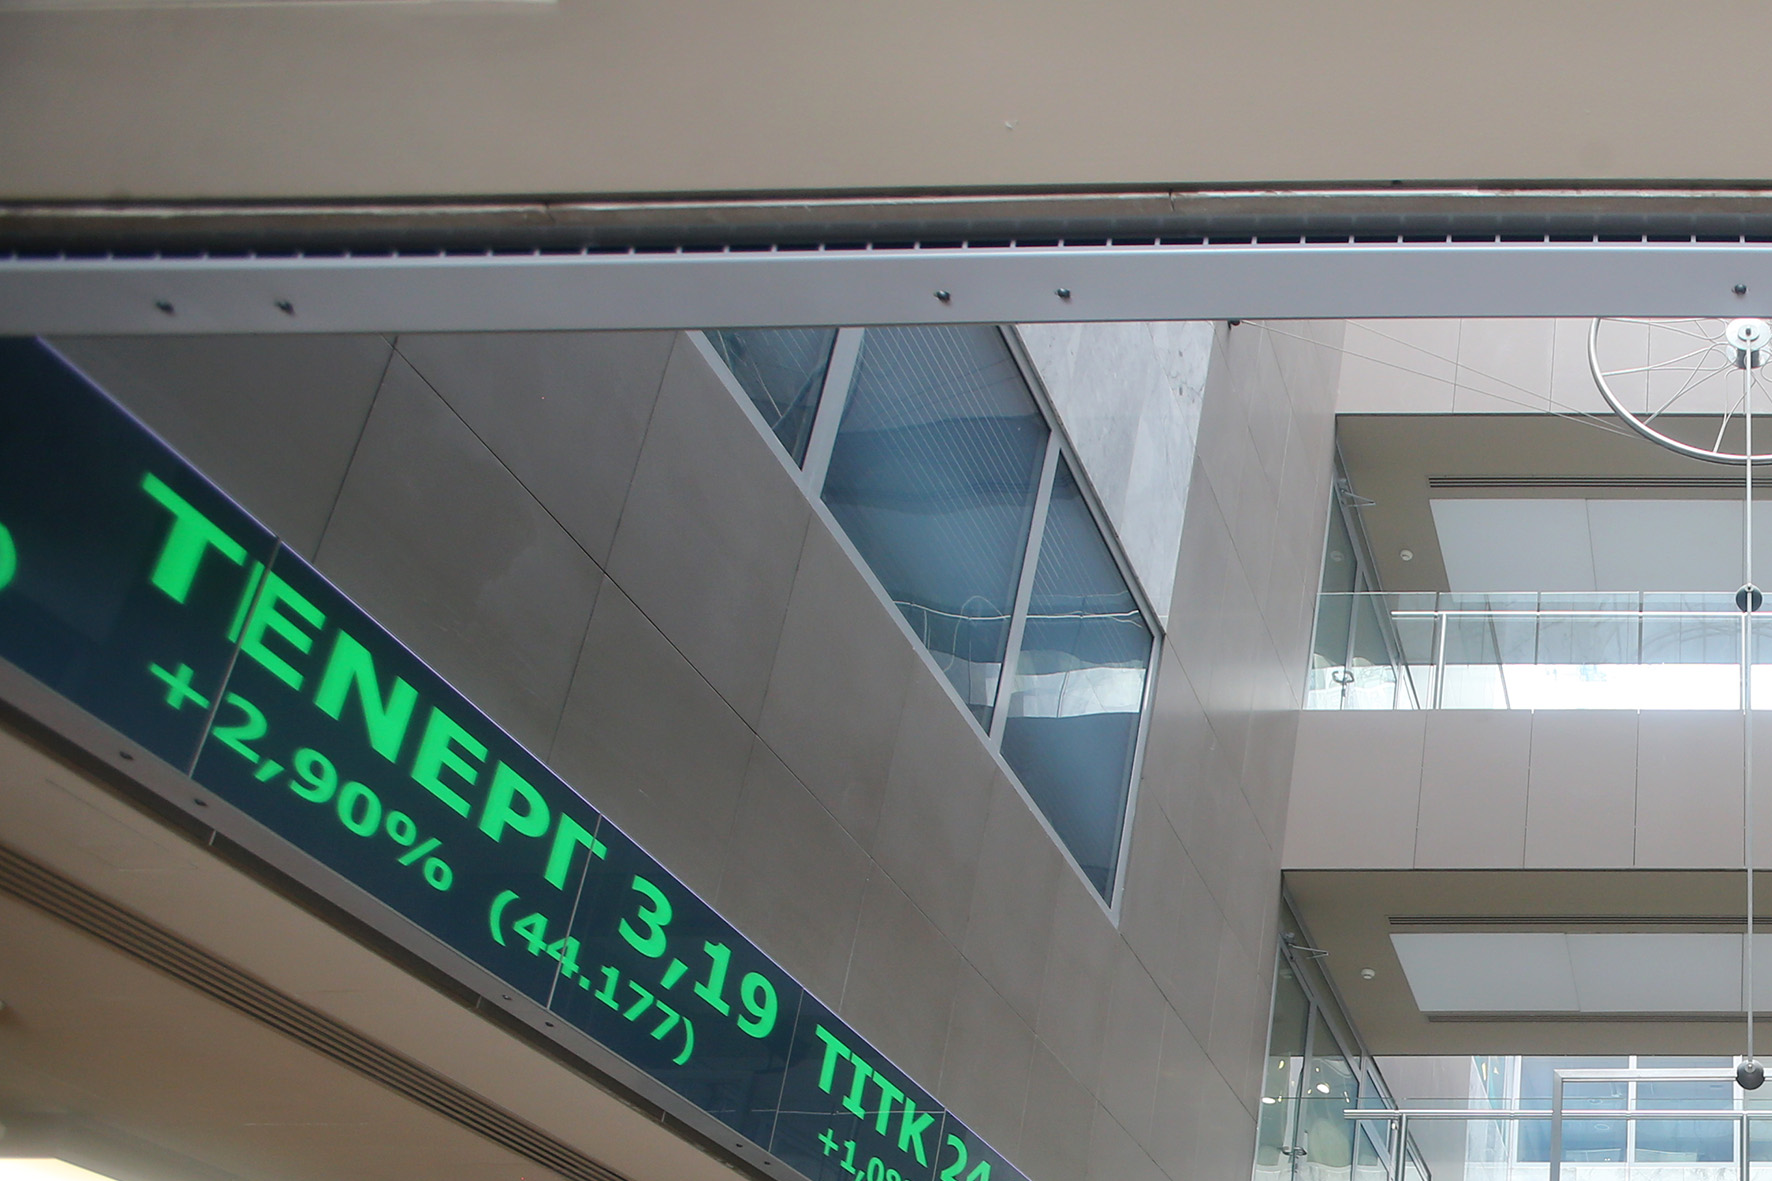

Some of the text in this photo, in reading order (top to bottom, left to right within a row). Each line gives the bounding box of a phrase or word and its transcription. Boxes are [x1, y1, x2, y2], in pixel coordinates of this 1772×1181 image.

[141, 472, 608, 892] ΤΕΝΕΡΓ
[617, 874, 779, 1041] 3,19
[815, 1024, 936, 1169] ΤΙΤΚ
[148, 662, 453, 892] +2,90%
[488, 889, 695, 1066] (44.177)
